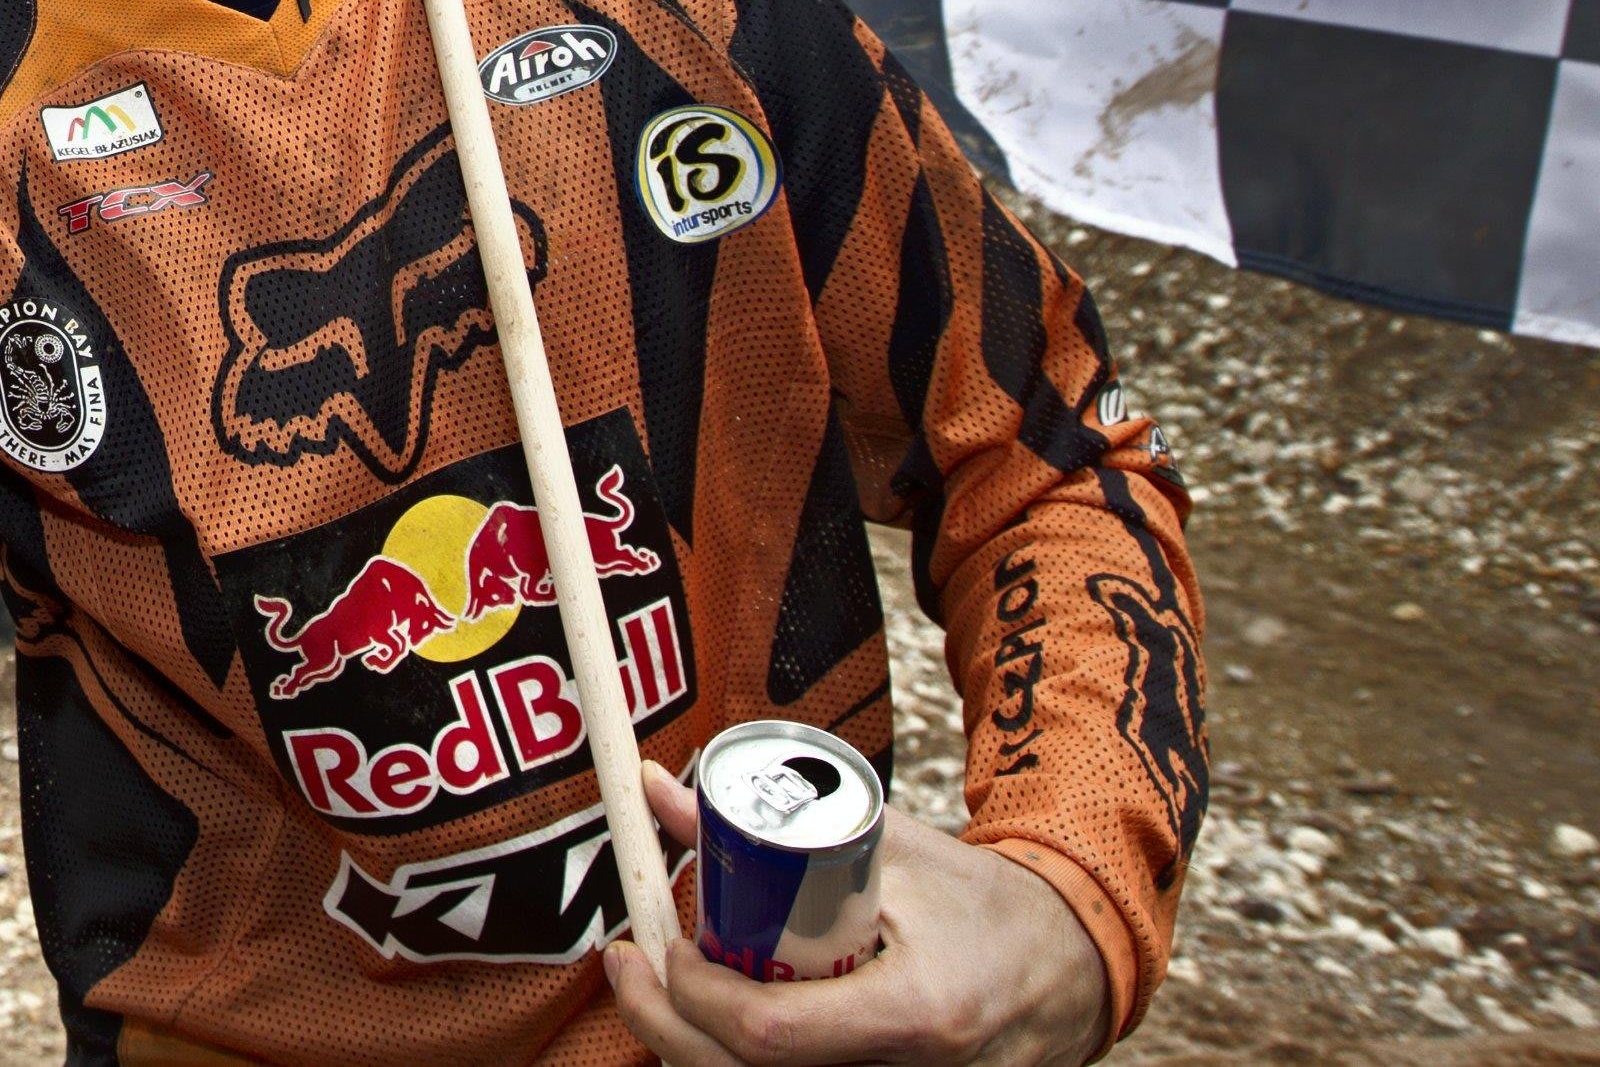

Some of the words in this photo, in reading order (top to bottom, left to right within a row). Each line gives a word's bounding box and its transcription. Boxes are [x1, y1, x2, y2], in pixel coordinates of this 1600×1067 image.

[489, 32, 607, 94] Airoh
[58, 172, 210, 234] TCX
[671, 200, 753, 237] intursports
[63, 318, 94, 359] BAY
[284, 672, 503, 816] Red
[763, 953, 855, 984] Bll
